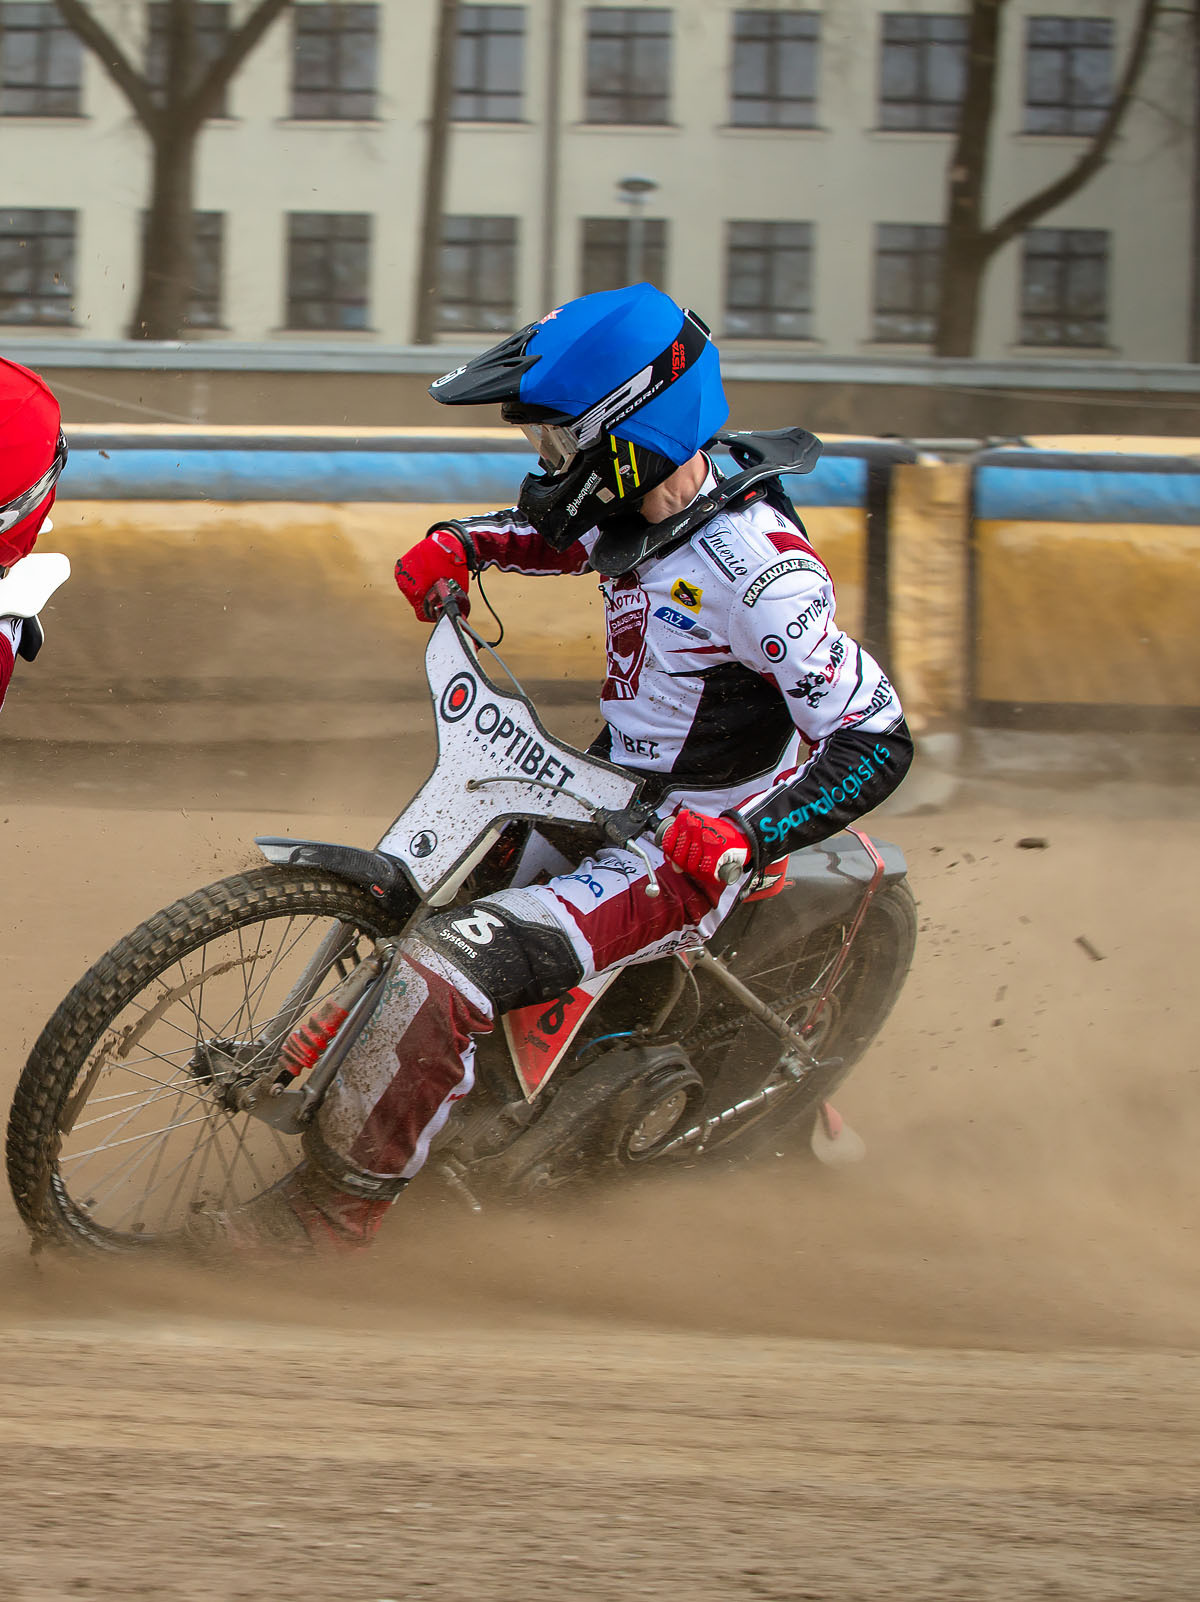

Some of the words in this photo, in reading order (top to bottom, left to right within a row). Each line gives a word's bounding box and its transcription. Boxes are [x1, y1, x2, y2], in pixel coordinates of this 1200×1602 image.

[671, 339, 681, 382] VISTA
[605, 379, 665, 430] PROGRIP
[572, 471, 600, 509] Husqvarna
[703, 520, 749, 577] Interio
[785, 597, 829, 640] OPTIBE
[474, 702, 576, 798] OPTIBET
[440, 928, 478, 959] Systems
